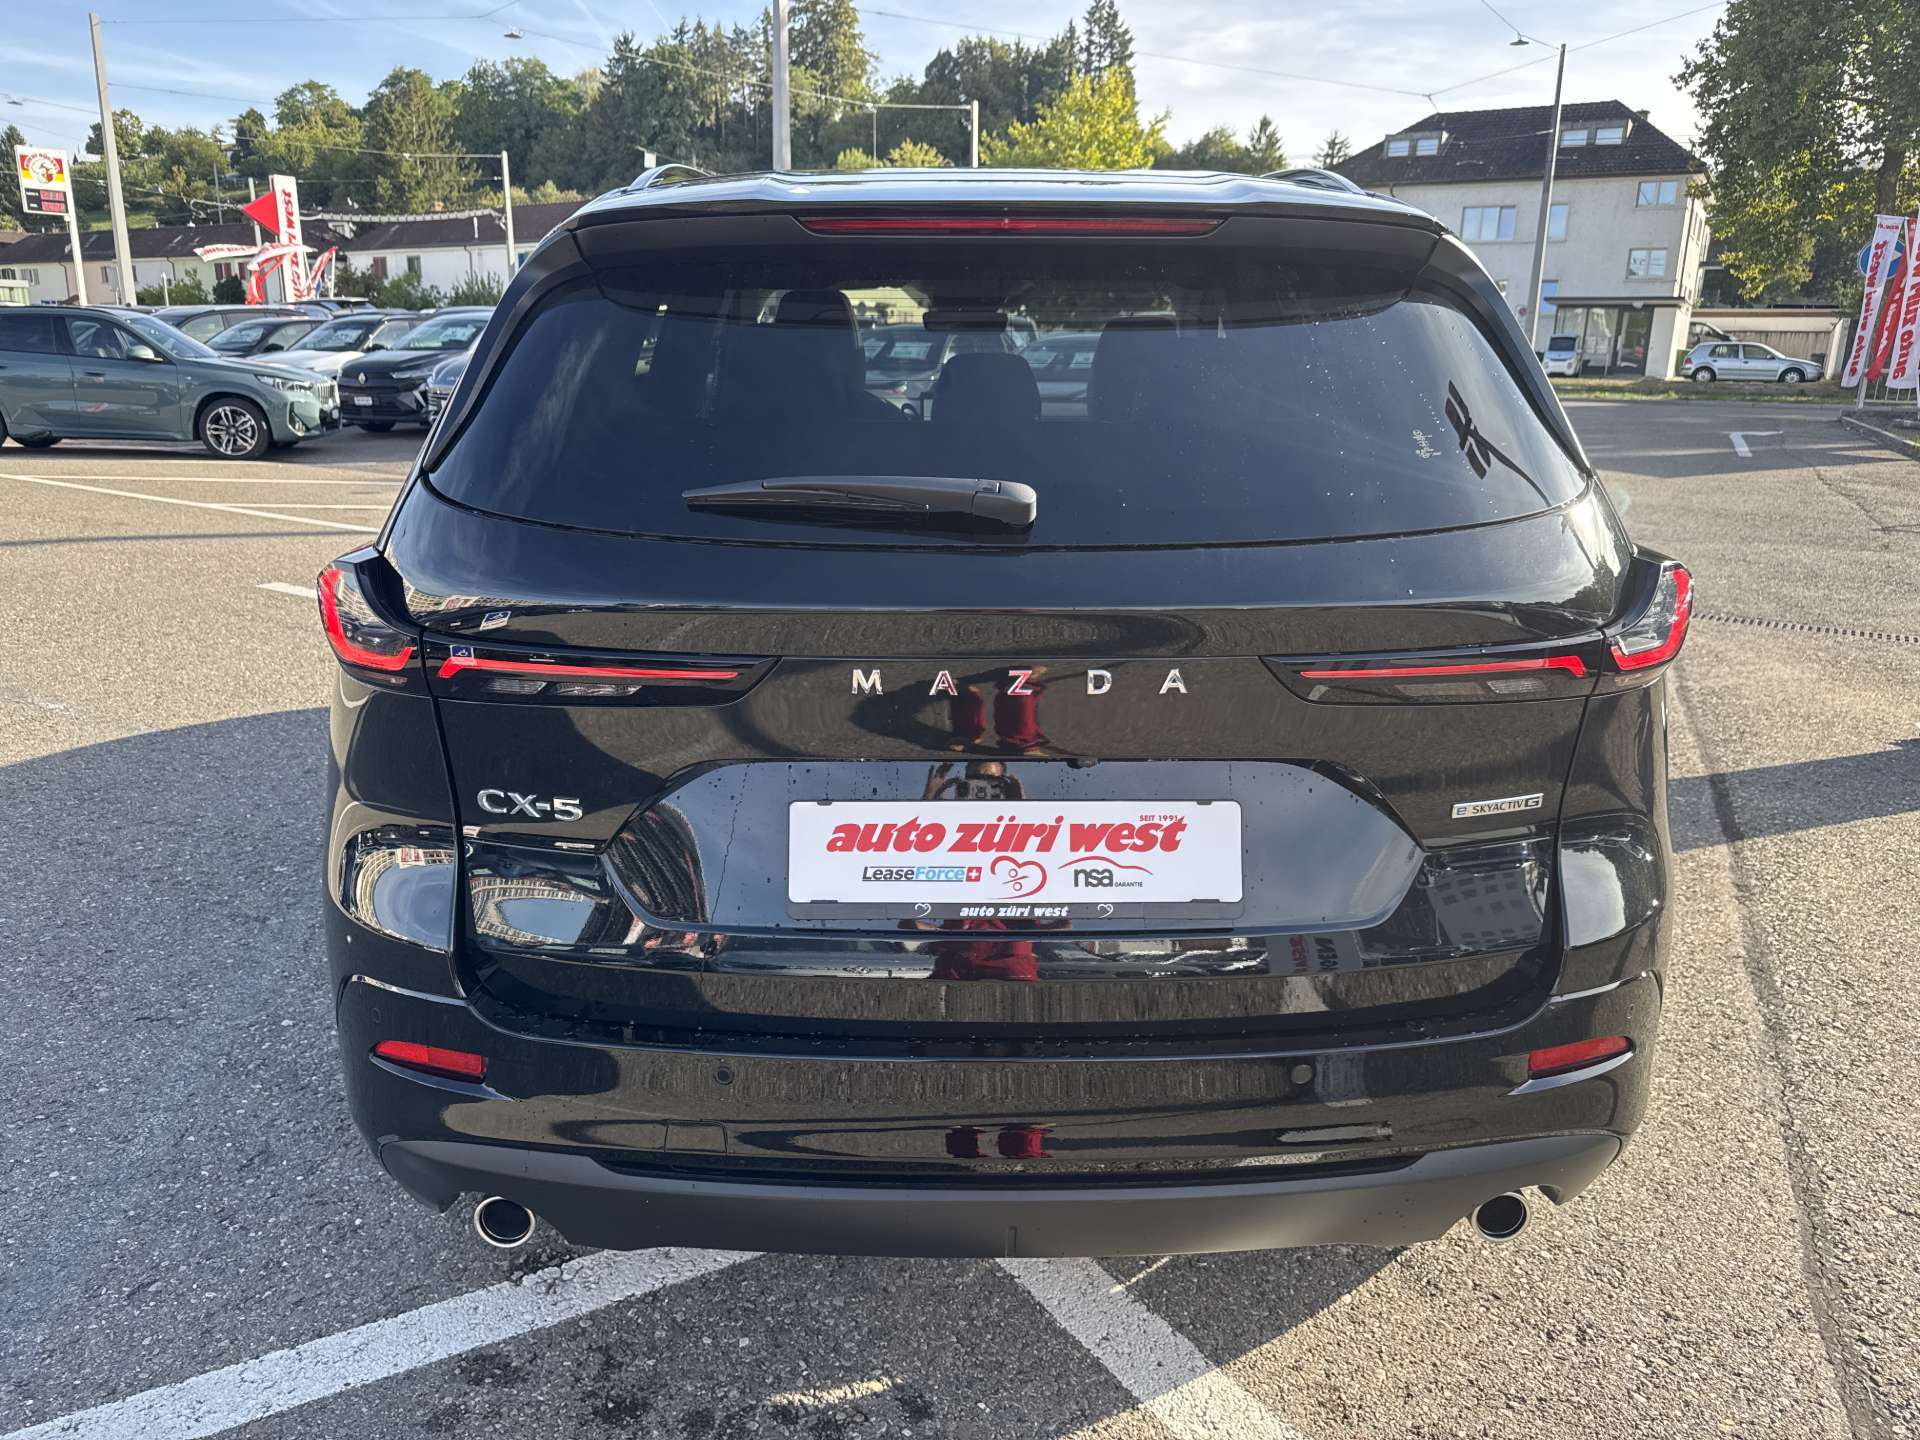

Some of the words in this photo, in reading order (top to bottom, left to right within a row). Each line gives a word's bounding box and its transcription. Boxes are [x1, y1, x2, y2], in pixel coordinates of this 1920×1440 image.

[852, 668, 1188, 696] MAZDA
[477, 789, 582, 821] CX-5
[1139, 814, 1156, 822] SEIT
[1158, 814, 1178, 822] 1991
[826, 815, 946, 852] auto
[947, 815, 1064, 852] züri
[1069, 815, 1188, 853] west
[862, 866, 967, 881] LeaseForce
[1074, 868, 1114, 888] nsa
[959, 905, 995, 917] auto
[997, 905, 1031, 917] züri
[1033, 906, 1070, 917] west
